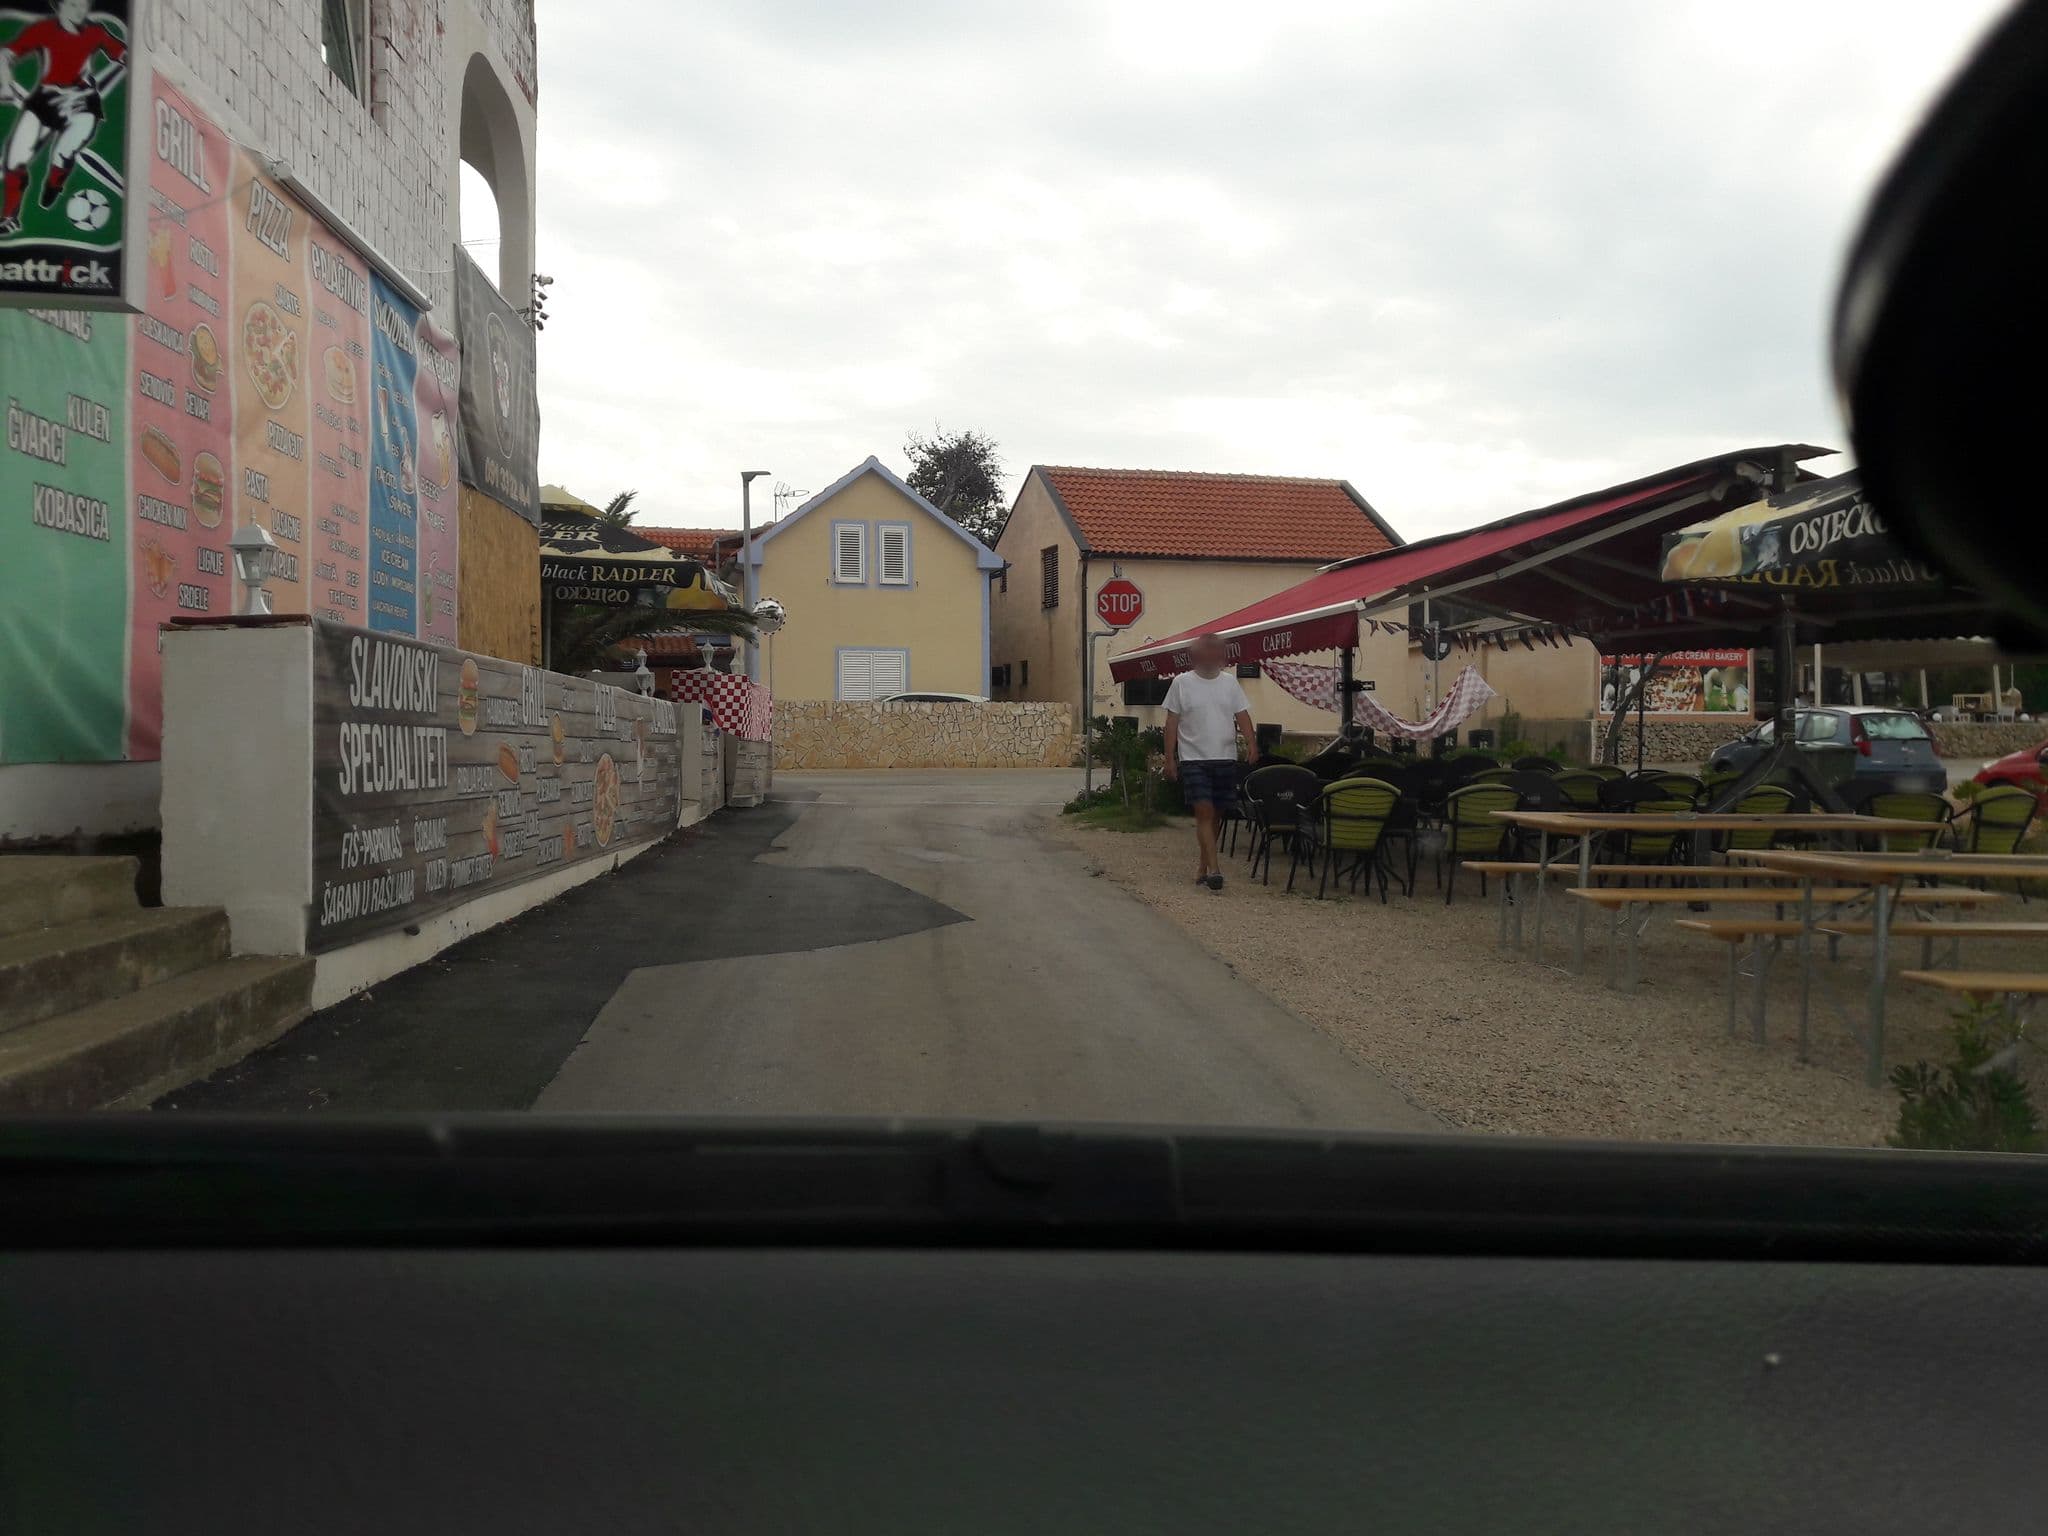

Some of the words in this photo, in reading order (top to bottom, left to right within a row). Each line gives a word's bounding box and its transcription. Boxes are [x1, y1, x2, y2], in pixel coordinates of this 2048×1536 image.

[155, 97, 211, 196] GRILL
[247, 177, 293, 263] PIZZA
[312, 241, 367, 318] PALAČINKE
[8, 395, 66, 467] ČVARCI
[67, 392, 110, 444] KULEN
[245, 466, 270, 504] PASTA
[33, 481, 110, 542] KOBASICA
[197, 546, 224, 576] LIGNJE
[541, 563, 589, 581] black
[591, 565, 678, 585] RADLER
[178, 582, 209, 612] SRDELE
[1100, 594, 1141, 613] STOP
[1262, 631, 1293, 652] CAFFE
[1684, 650, 1709, 661] CREAM
[1714, 652, 1743, 662] BAKERY
[350, 635, 438, 713] SLAVONSKI
[522, 666, 549, 727] GRILL
[339, 721, 448, 795] SPECIJALITETI
[341, 818, 402, 870] FIŠ-PAPRIKAŠ
[320, 877, 361, 927] ŠARAN
[361, 879, 371, 916] U
